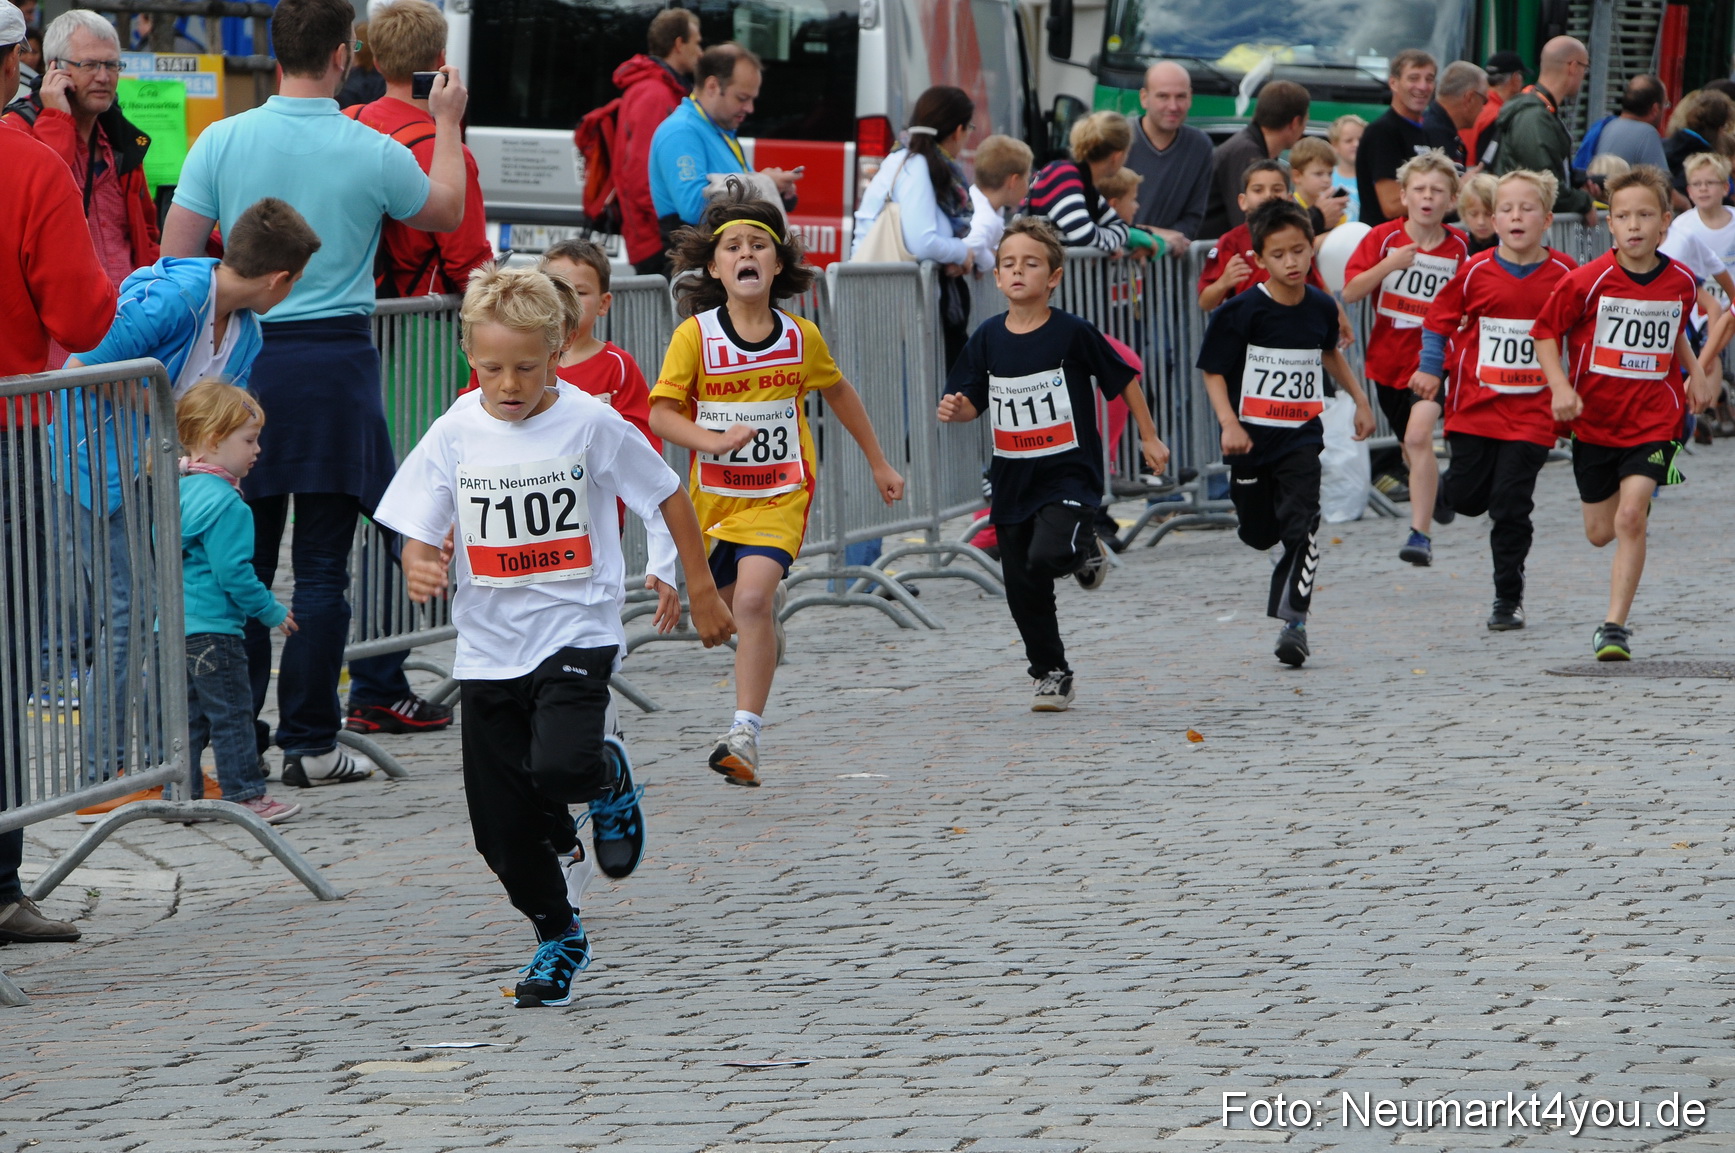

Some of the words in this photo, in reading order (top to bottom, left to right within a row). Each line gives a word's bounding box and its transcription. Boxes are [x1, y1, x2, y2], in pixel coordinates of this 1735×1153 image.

[156, 56, 197, 72] STATT
[1397, 299, 1429, 315] Bastia
[1601, 305, 1631, 315] PARTL
[1633, 308, 1670, 317] Neumarkt
[1482, 323, 1506, 334] PARTL
[1608, 316, 1670, 349] 7099
[1488, 335, 1538, 365] 709
[1248, 352, 1276, 365] PARTL
[1278, 357, 1314, 366] Neumarkt
[1620, 355, 1650, 370] Lauri
[705, 377, 751, 396] MAX
[758, 370, 802, 391] BÖGL
[1254, 368, 1315, 399] 7238
[1500, 371, 1534, 384] Lukas
[1006, 380, 1050, 395] Neumarkt
[700, 411, 732, 422] PARTL
[735, 410, 783, 422] Neumarkt
[992, 391, 1057, 427] 7111
[1265, 403, 1302, 418] Julian
[1012, 434, 1045, 448] Timo
[460, 477, 497, 491] PARTL
[500, 470, 566, 490] Neumarkt
[723, 469, 777, 486] Samuel
[470, 487, 580, 539] 7102
[497, 549, 561, 572] Tobias
